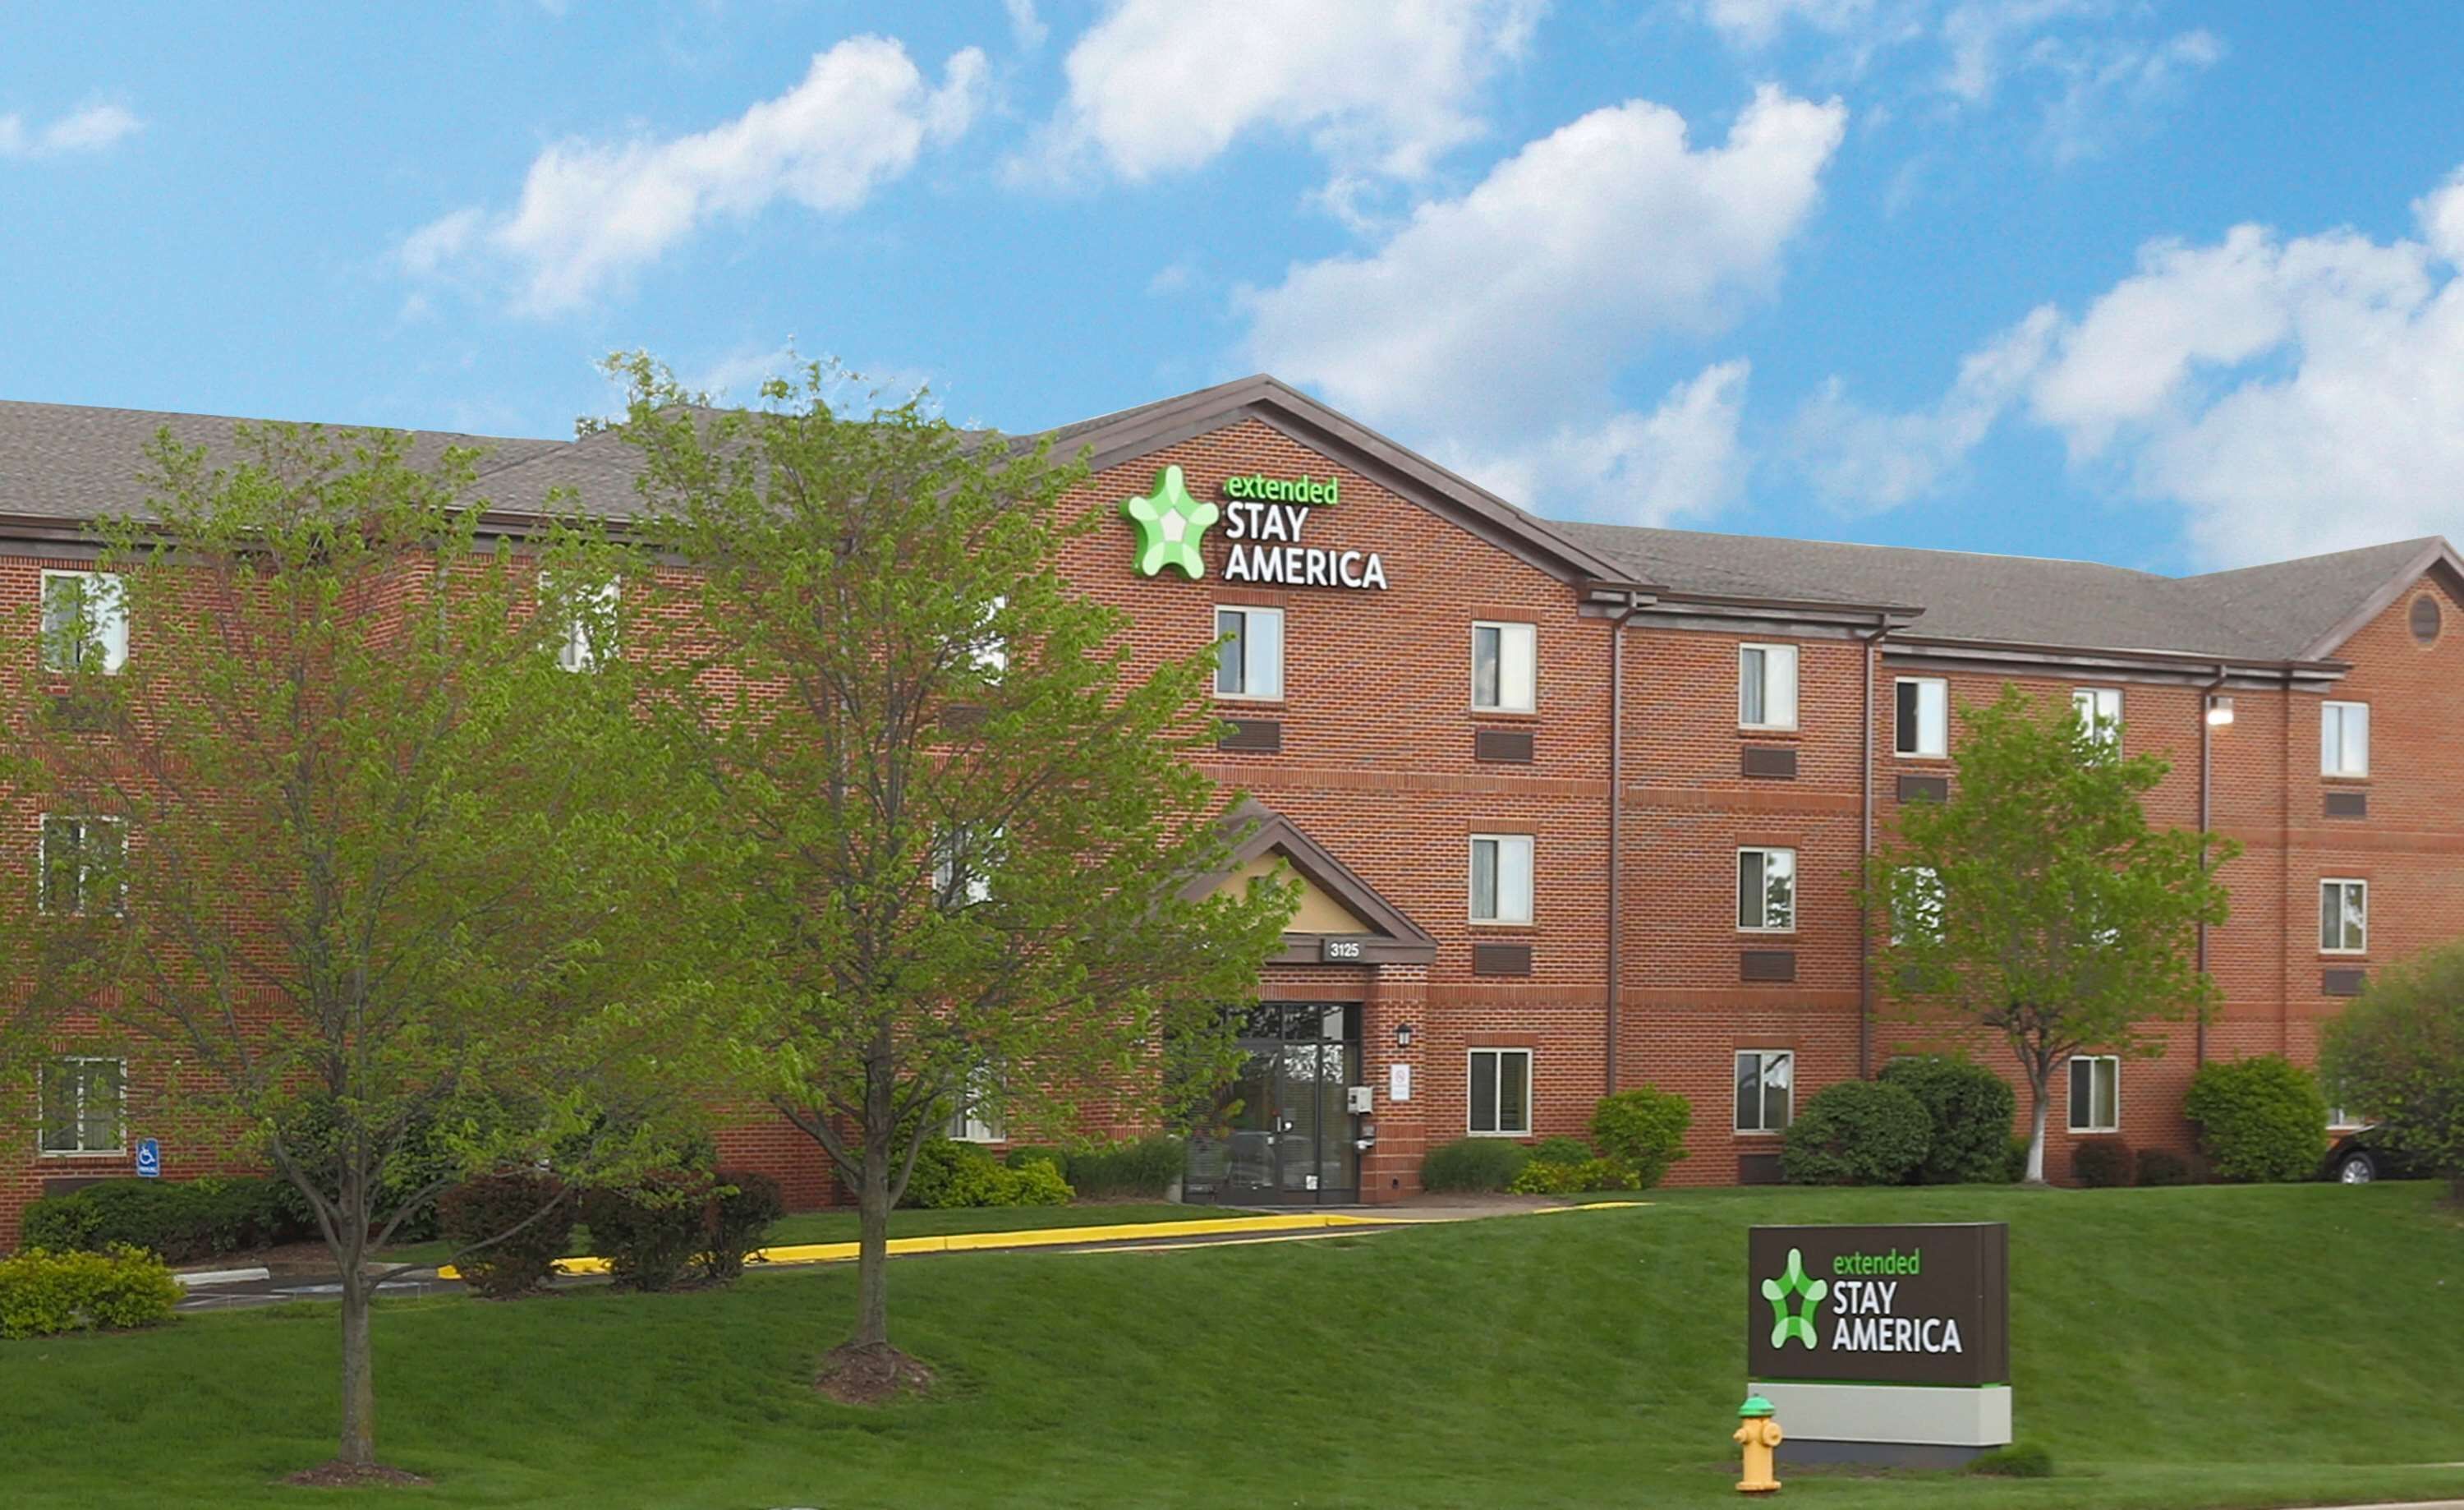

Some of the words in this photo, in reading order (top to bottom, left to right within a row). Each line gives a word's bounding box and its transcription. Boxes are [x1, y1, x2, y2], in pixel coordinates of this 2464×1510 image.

[1227, 473, 1339, 505] extended
[1225, 501, 1309, 542] STAY
[1225, 544, 1388, 590] AMERICA
[1331, 942, 1359, 957] 3125
[1832, 1248, 1921, 1275] extended
[1832, 1280, 1897, 1314] STAY
[1831, 1318, 1963, 1353] AMERICA
